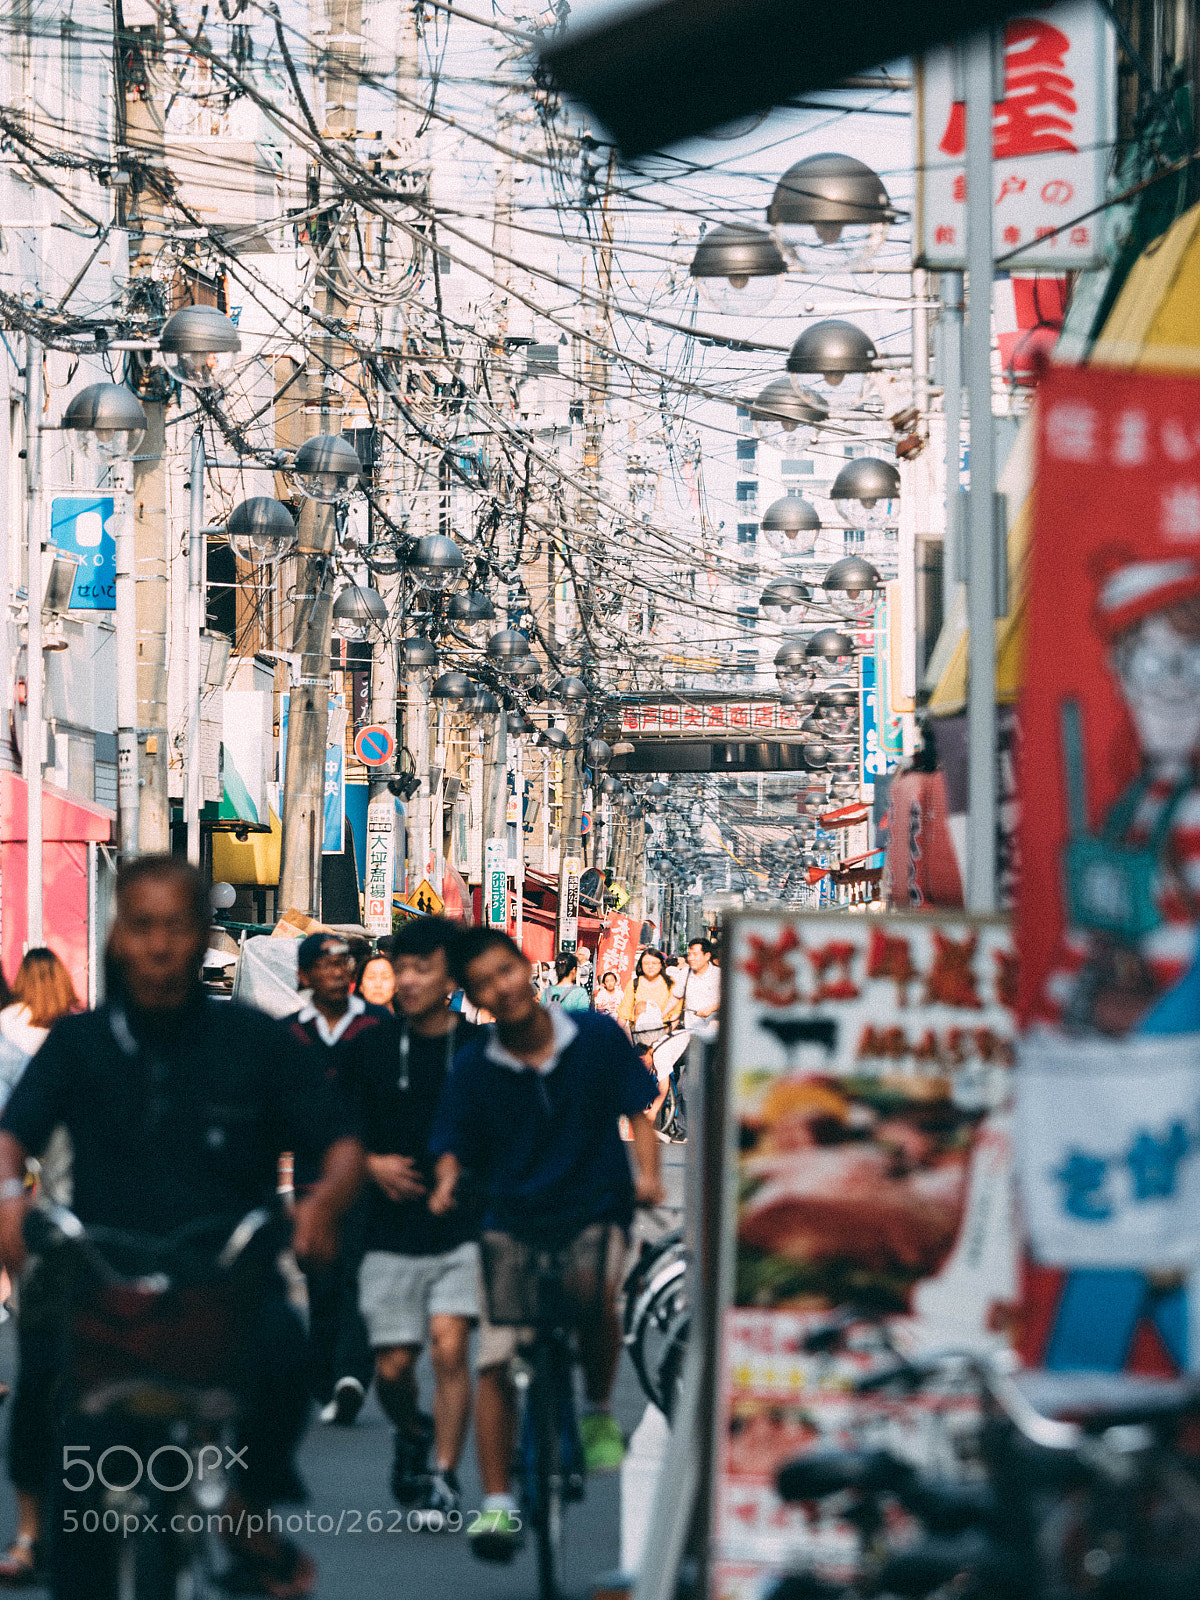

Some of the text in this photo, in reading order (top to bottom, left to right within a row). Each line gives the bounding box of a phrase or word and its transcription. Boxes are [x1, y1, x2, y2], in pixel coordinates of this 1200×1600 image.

[324, 759, 339, 797] 中央
[491, 872, 500, 909] クリニック
